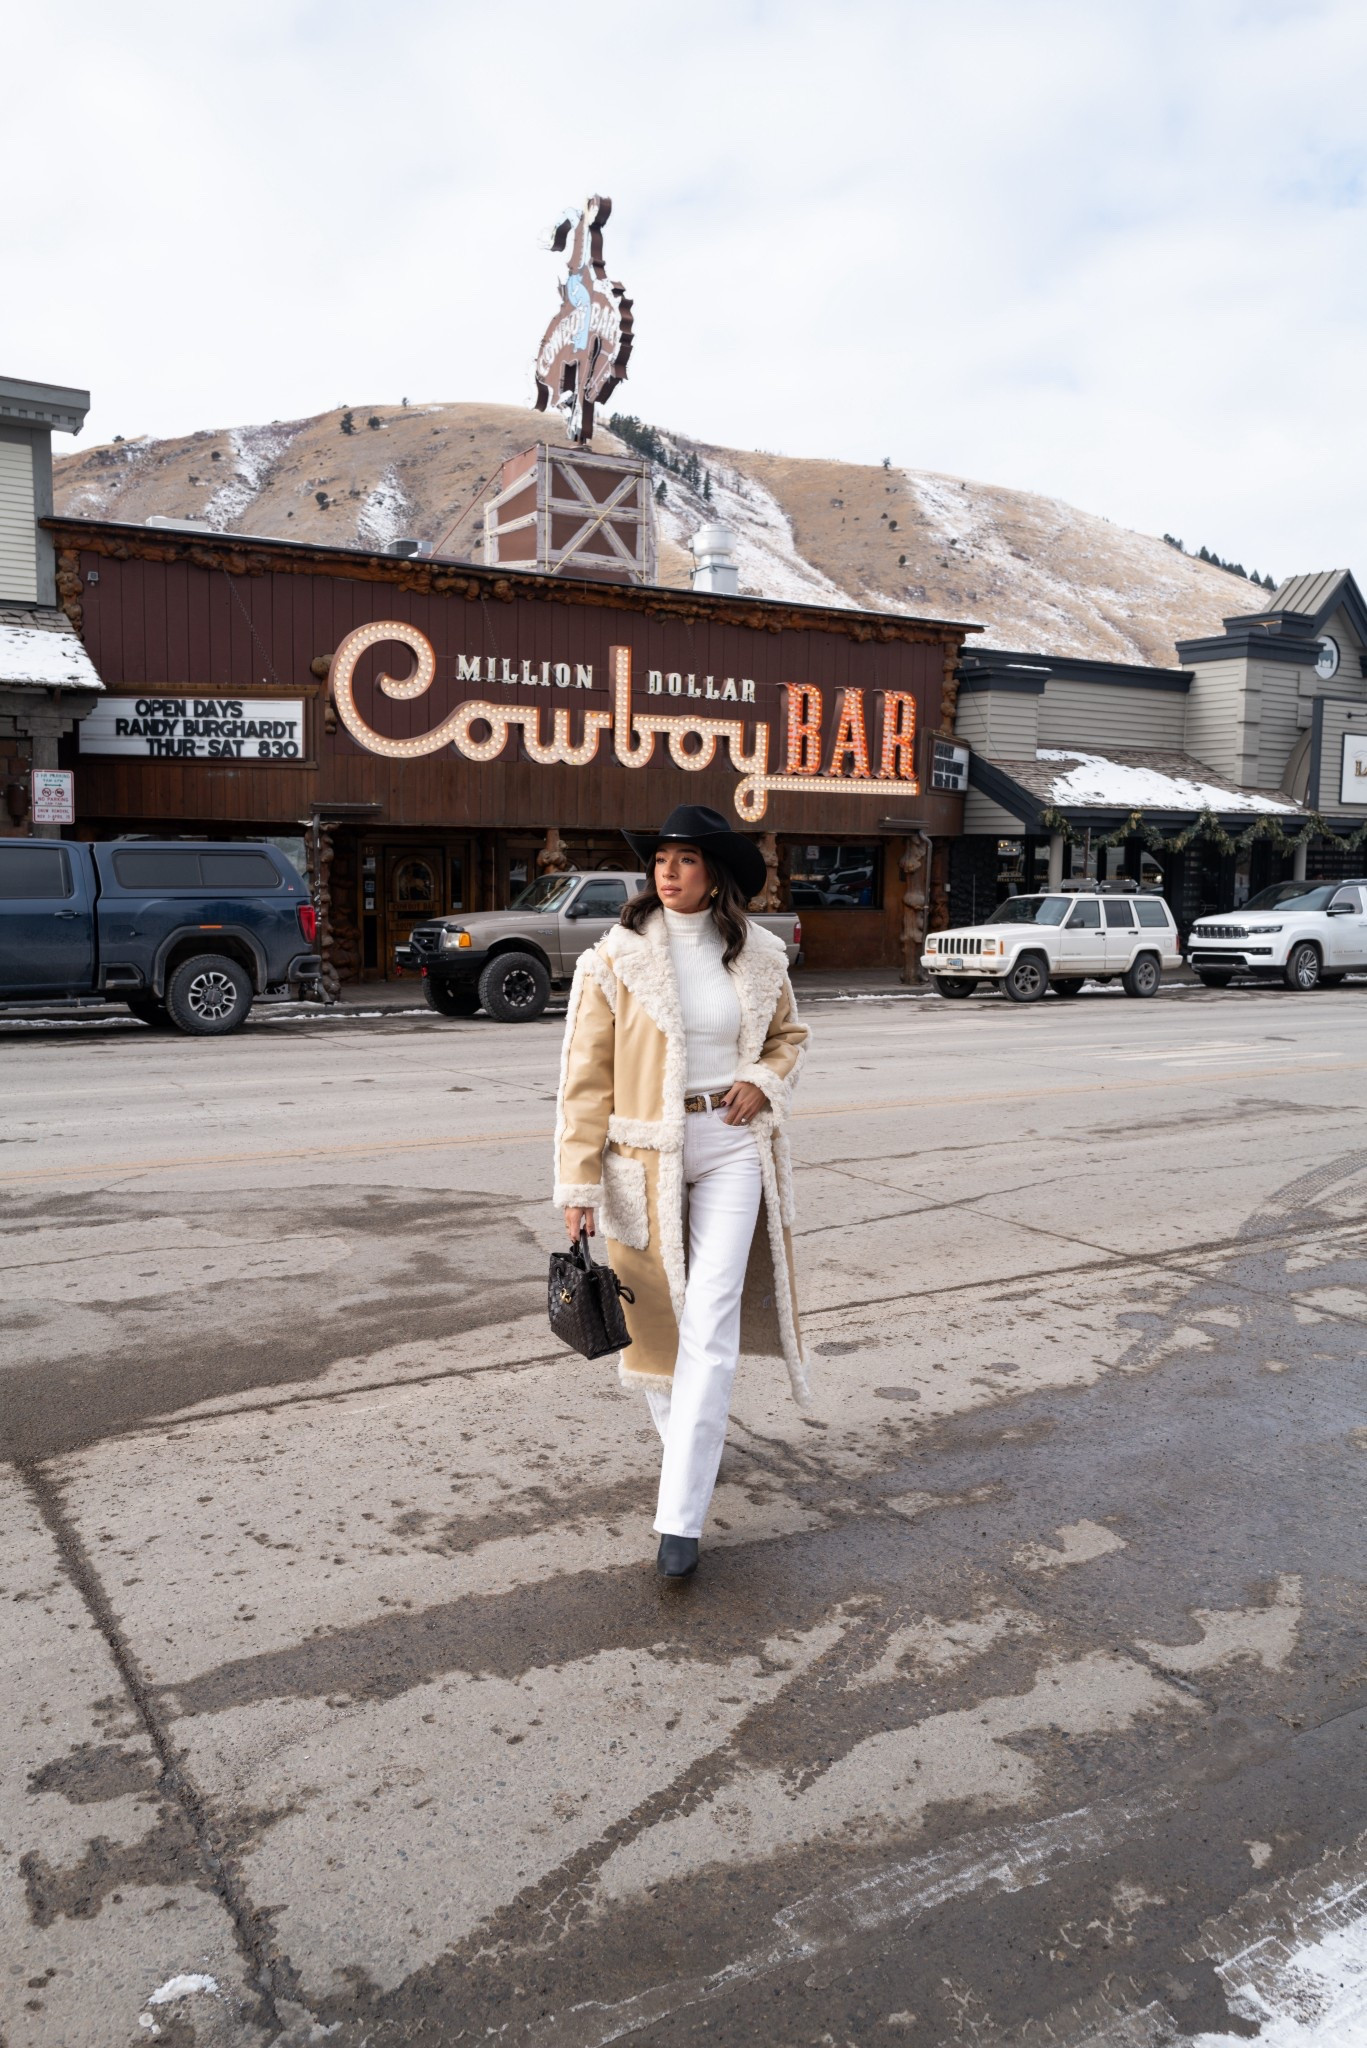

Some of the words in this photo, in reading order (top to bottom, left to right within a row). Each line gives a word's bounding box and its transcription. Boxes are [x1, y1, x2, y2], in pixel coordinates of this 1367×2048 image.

[538, 306, 587, 376] COWBOY
[590, 302, 618, 345] BAR
[456, 655, 594, 689] MILLION
[646, 670, 757, 703] DOLLAR
[135, 699, 186, 718] OPEN
[193, 701, 243, 719] DAYS
[328, 620, 770, 823] Cowboy
[776, 682, 919, 780] BAR
[115, 718, 179, 737] RANDY
[183, 719, 298, 739] BURGHARDT
[146, 738, 245, 758] THUR-SAT
[257, 740, 299, 759] 830
